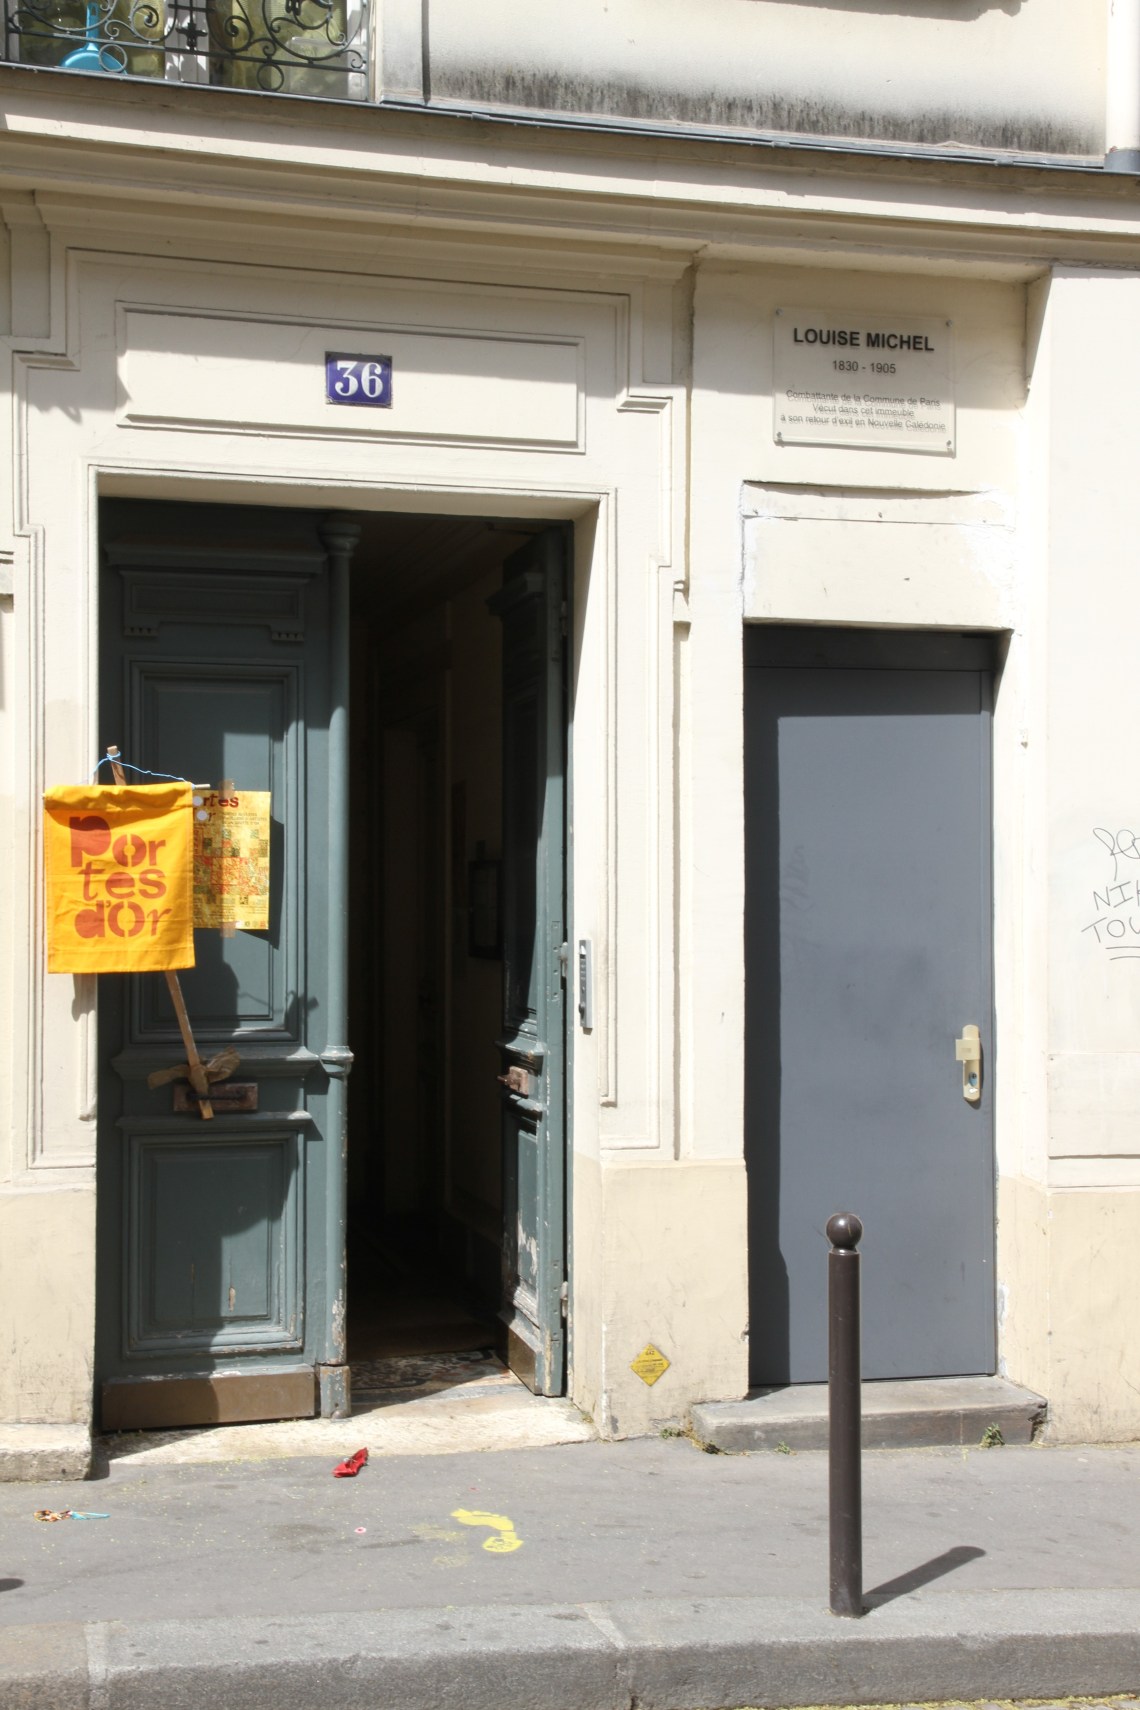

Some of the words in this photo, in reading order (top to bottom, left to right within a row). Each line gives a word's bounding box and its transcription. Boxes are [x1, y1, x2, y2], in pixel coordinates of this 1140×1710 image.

[793, 328, 860, 347] LOUISE
[866, 332, 935, 351] MICHEL
[833, 360, 859, 372] 1830
[870, 362, 896, 374] 1905
[334, 360, 383, 398] 36
[786, 389, 838, 401] Combattante
[841, 393, 851, 401] de
[853, 394, 861, 402] la
[863, 394, 905, 405] Commune
[907, 397, 917, 405] de
[920, 397, 941, 407] Paris
[838, 405, 858, 414] dans
[861, 407, 873, 415] cet
[875, 407, 914, 417] immeuble
[805, 415, 829, 424] retour
[855, 418, 866, 426] en
[868, 418, 902, 428] Nouvelle
[77, 861, 167, 901] tes
